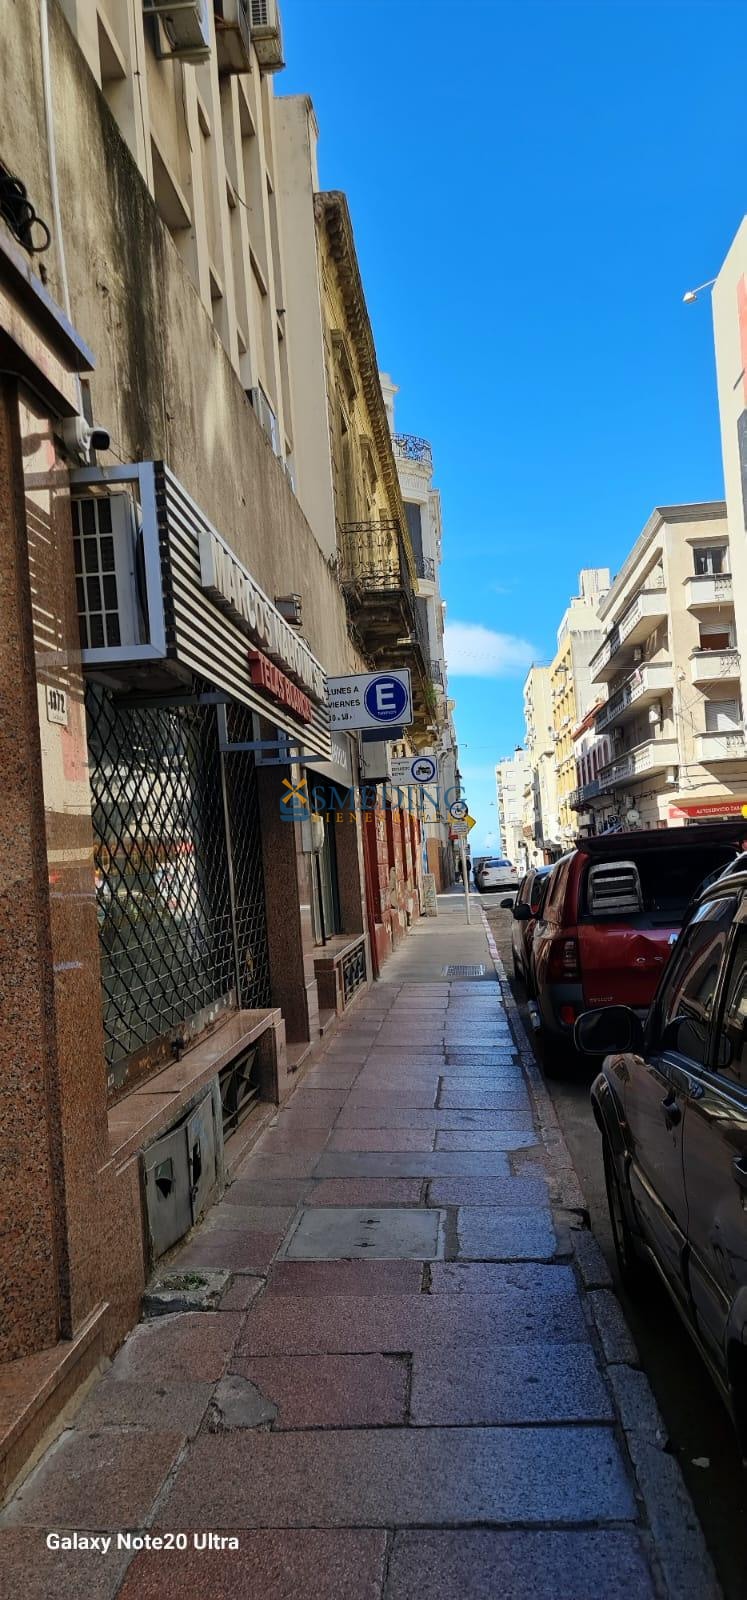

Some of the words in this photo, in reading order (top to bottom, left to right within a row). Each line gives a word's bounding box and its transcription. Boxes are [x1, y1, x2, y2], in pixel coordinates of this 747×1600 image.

[198, 531, 273, 648] MARCOS
[248, 651, 286, 700] TELAS
[327, 686, 352, 696] LUNES
[353, 685, 359, 693] A
[328, 699, 361, 709] VIERNES
[375, 683, 397, 711] E
